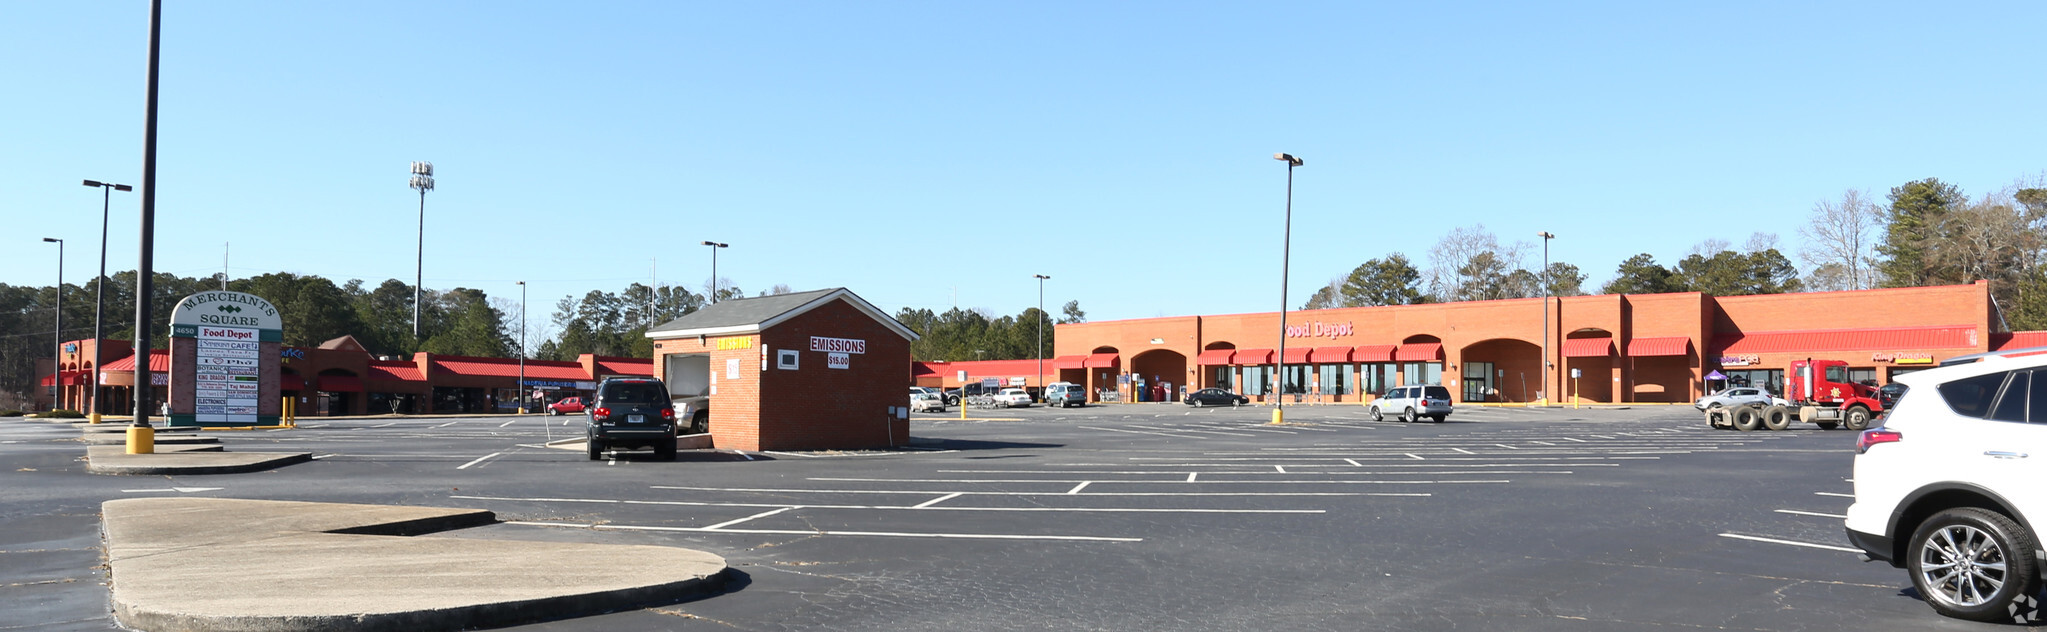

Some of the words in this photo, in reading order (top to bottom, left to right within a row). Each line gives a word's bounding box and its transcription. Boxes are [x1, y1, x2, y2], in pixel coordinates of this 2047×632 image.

[183, 292, 276, 317] MERCHANTS
[200, 314, 259, 326] SQUARE
[203, 328, 225, 337] Food
[227, 330, 252, 339] Depot
[1285, 321, 1311, 338] ood
[1314, 320, 1354, 340] Depot
[717, 336, 752, 350] EMISSIONS
[811, 338, 864, 353] EMISSIONS
[829, 356, 849, 365] $15.00
